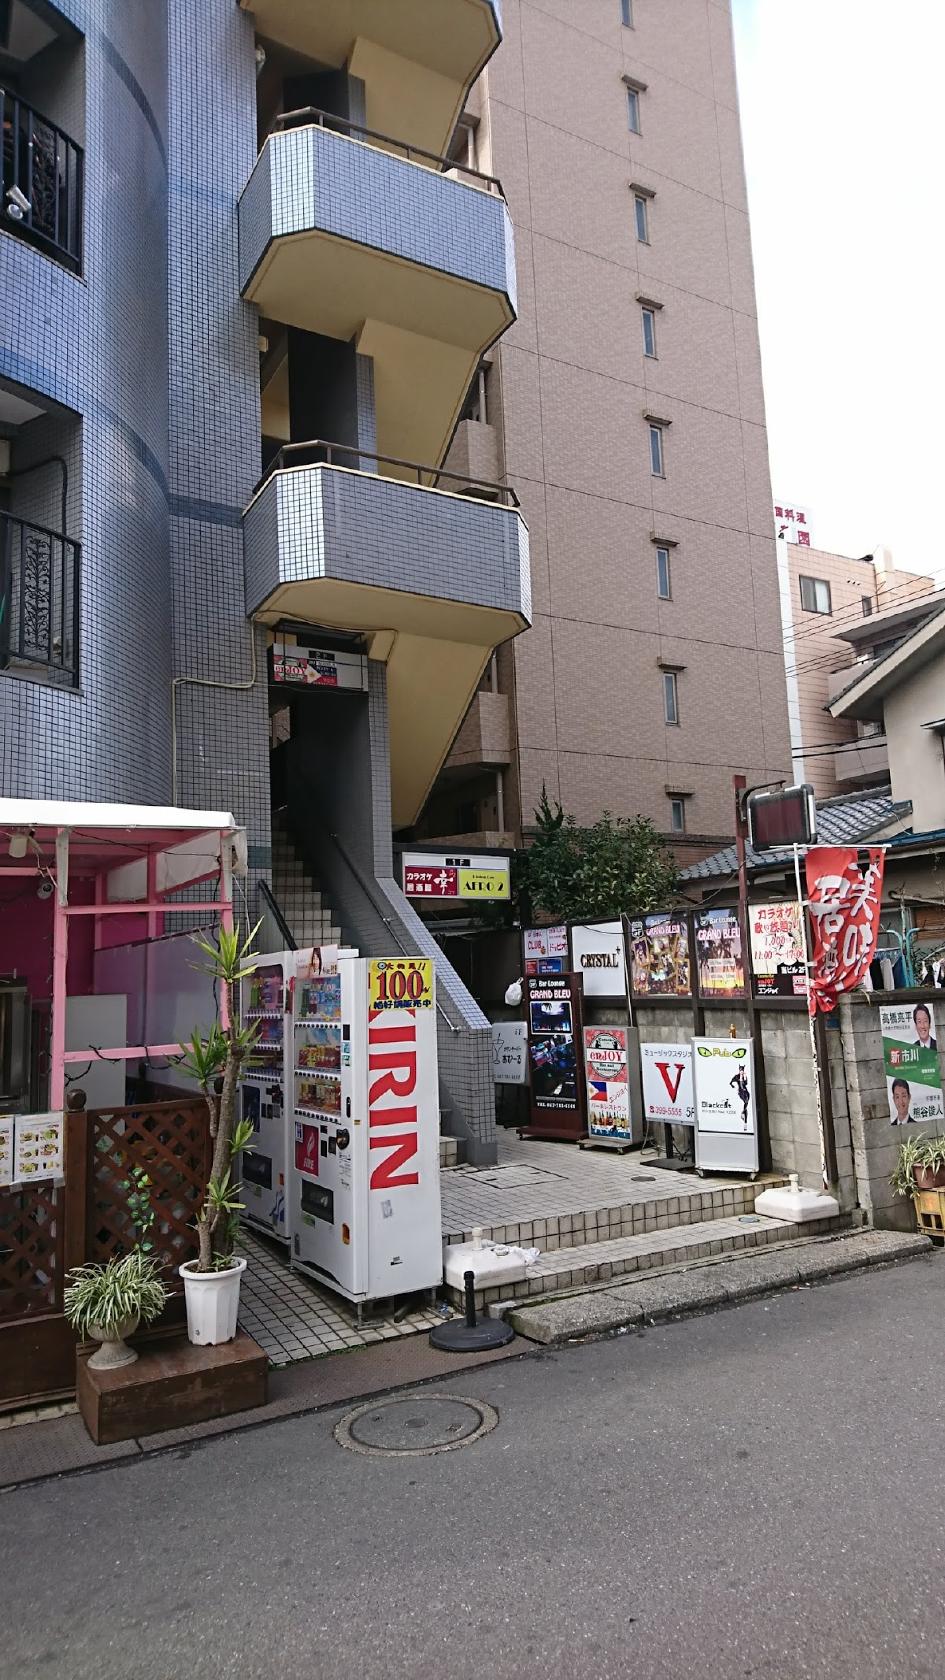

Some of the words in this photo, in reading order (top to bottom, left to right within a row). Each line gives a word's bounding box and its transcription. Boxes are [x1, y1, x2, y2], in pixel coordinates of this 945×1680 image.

[406, 872, 432, 881] カラオケ
[463, 881, 494, 892] AFRO
[497, 882, 504, 892] 2
[757, 906, 793, 920] カラオケ
[665, 924, 681, 934] BLEU
[697, 929, 722, 941] GRAND
[722, 927, 741, 939] BLEU
[530, 989, 553, 999] GRAND
[553, 988, 571, 999] BLEU
[881, 1011, 912, 1024] 高橋亮平
[590, 1050, 622, 1062] enJOY
[712, 1047, 732, 1057] Pub
[654, 1062, 686, 1104] V
